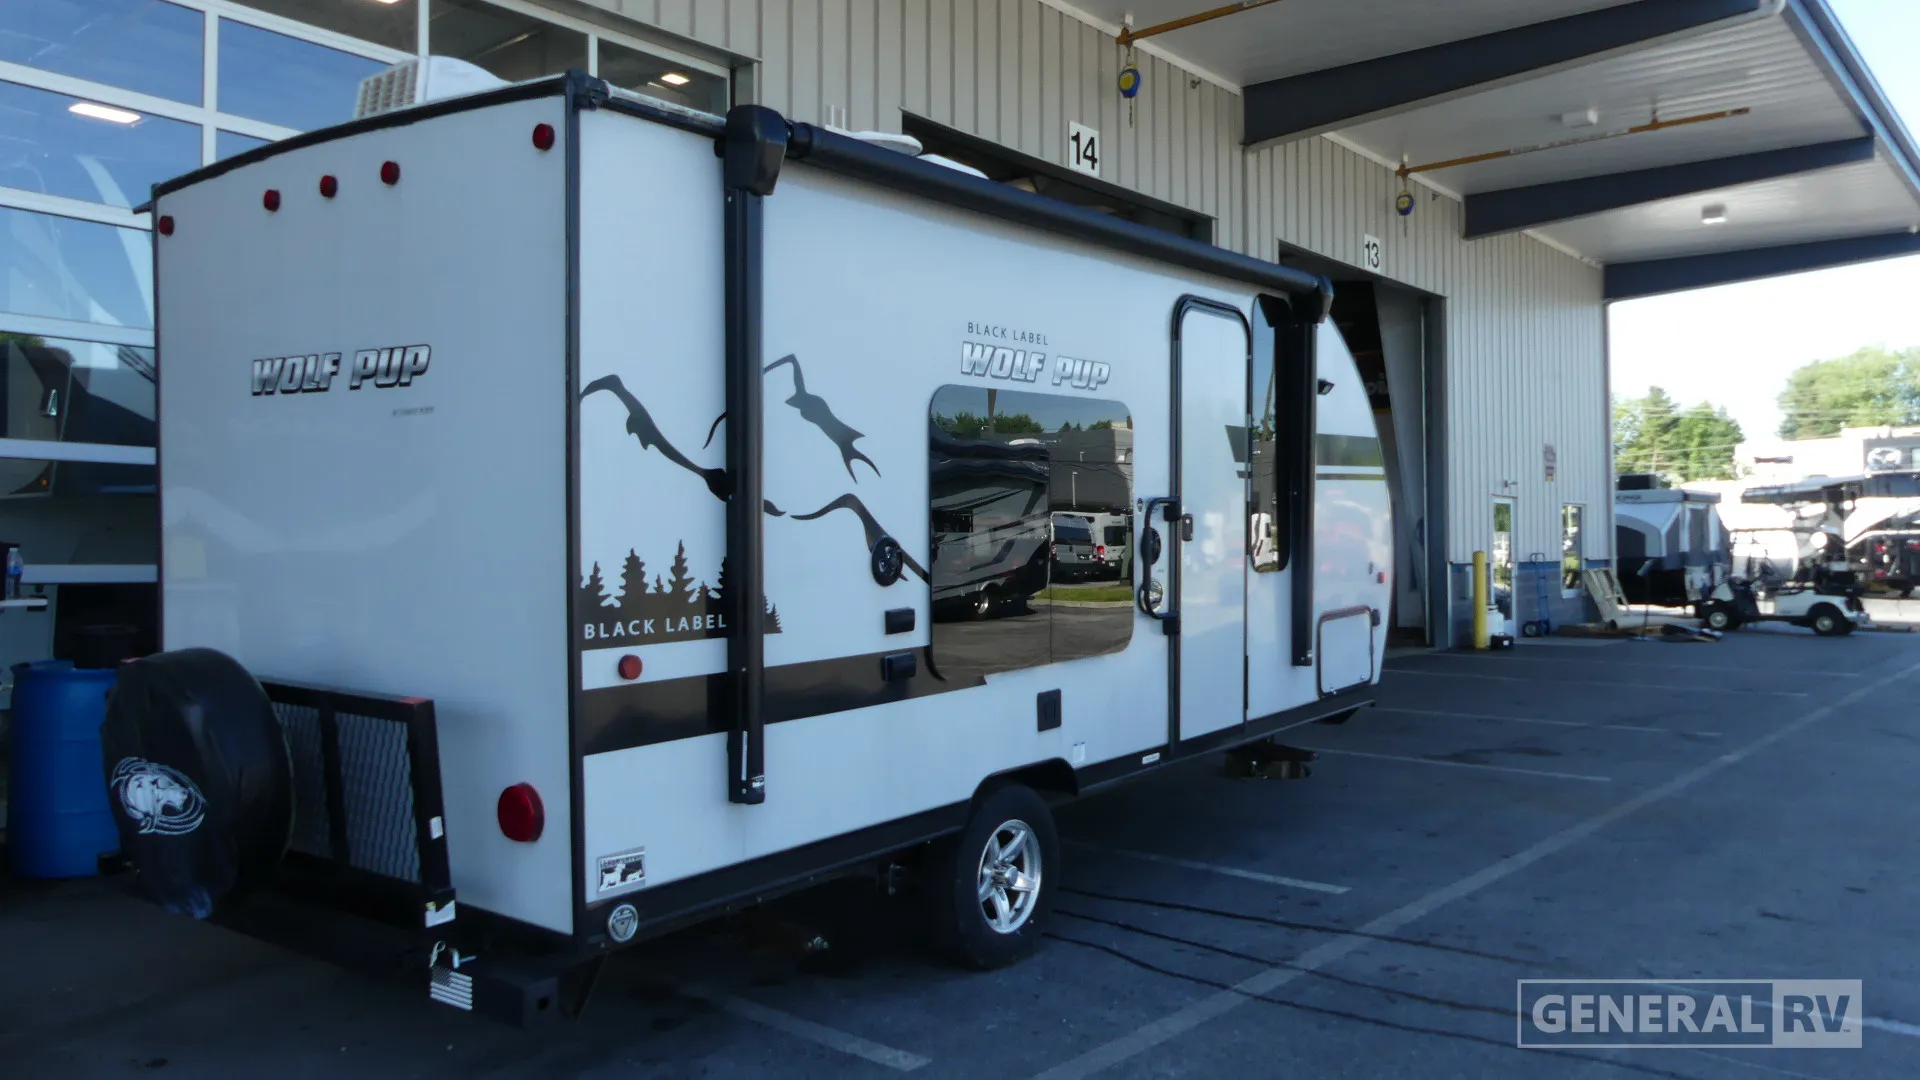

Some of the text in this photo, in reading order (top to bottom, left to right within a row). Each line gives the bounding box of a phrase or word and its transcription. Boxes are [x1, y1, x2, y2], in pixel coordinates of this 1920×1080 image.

[1071, 131, 1098, 170] 14
[1365, 240, 1380, 268] 13
[967, 322, 1049, 346] BLACK LABEL
[252, 343, 432, 397] WOLF PUP
[961, 340, 1111, 391] WOLF PUP
[584, 614, 727, 640] BLACK LABEL
